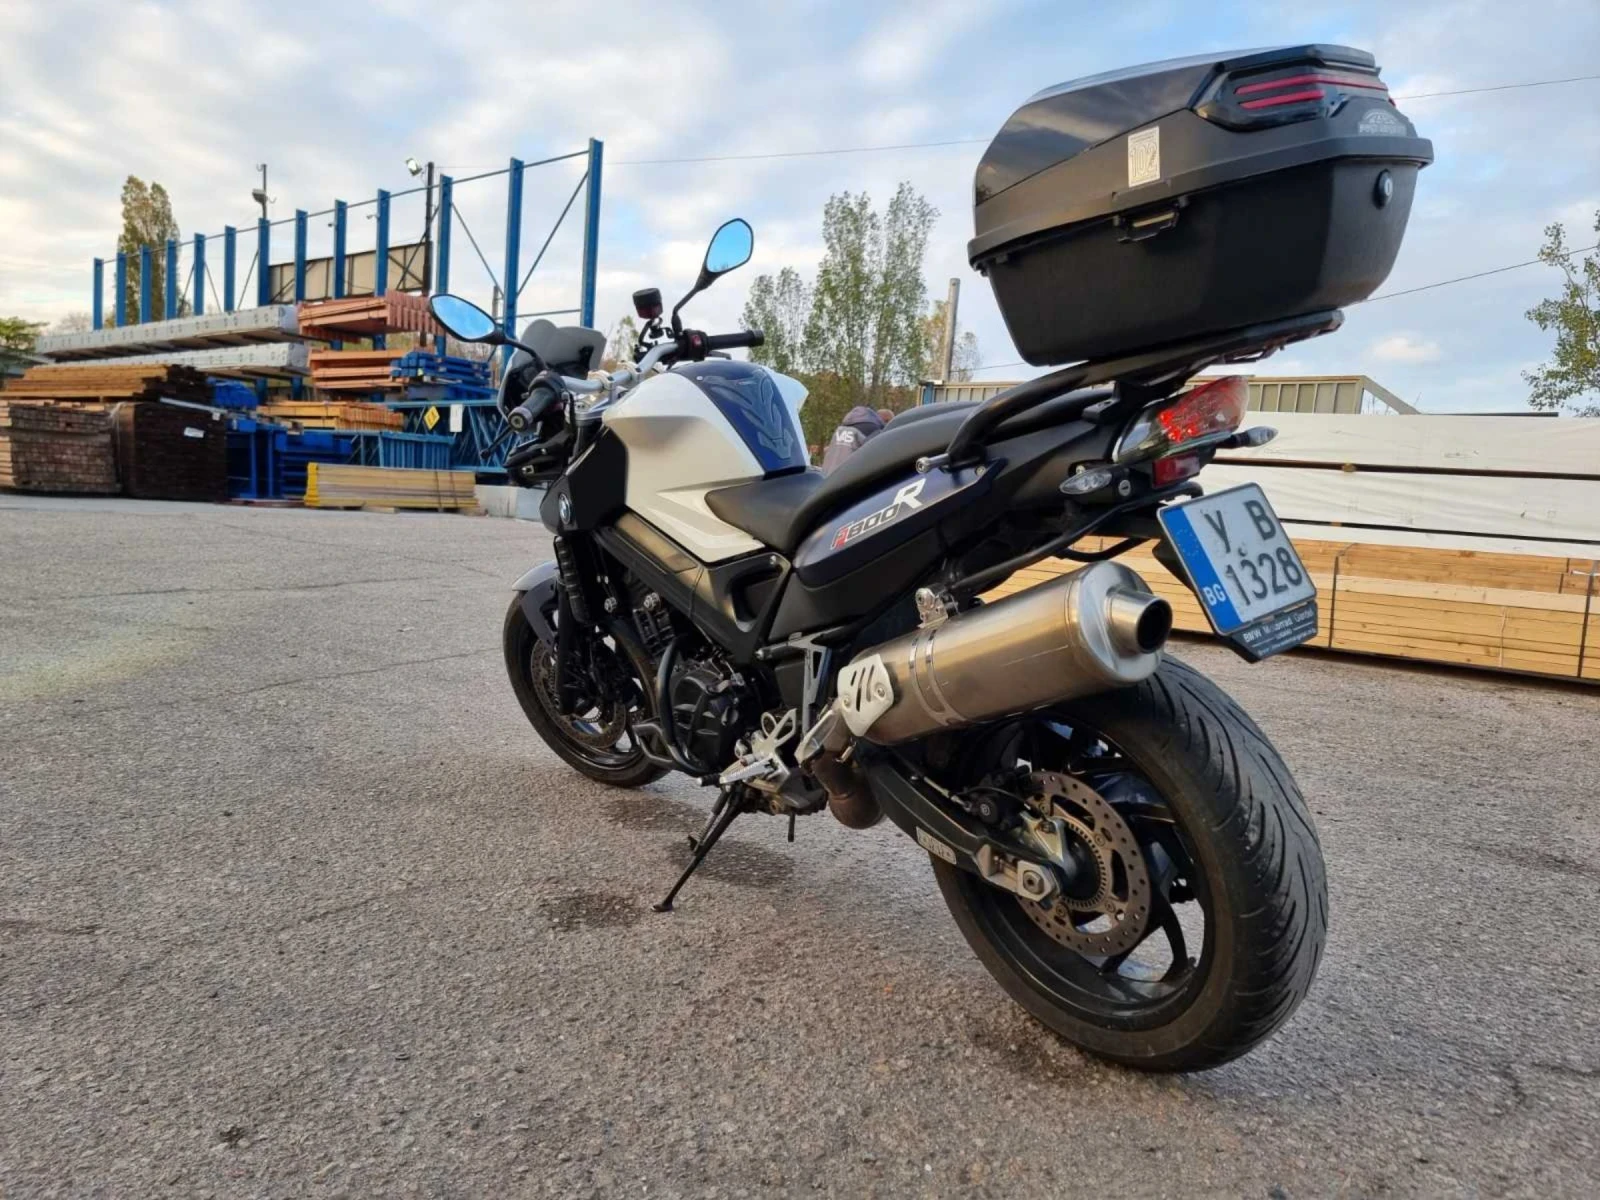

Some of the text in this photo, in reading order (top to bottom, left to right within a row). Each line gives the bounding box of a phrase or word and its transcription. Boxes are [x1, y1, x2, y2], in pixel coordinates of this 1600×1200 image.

[1203, 500, 1277, 554] Y B
[1202, 583, 1227, 606] BG
[1225, 546, 1303, 606] 1328
[1243, 626, 1262, 643] BMW
